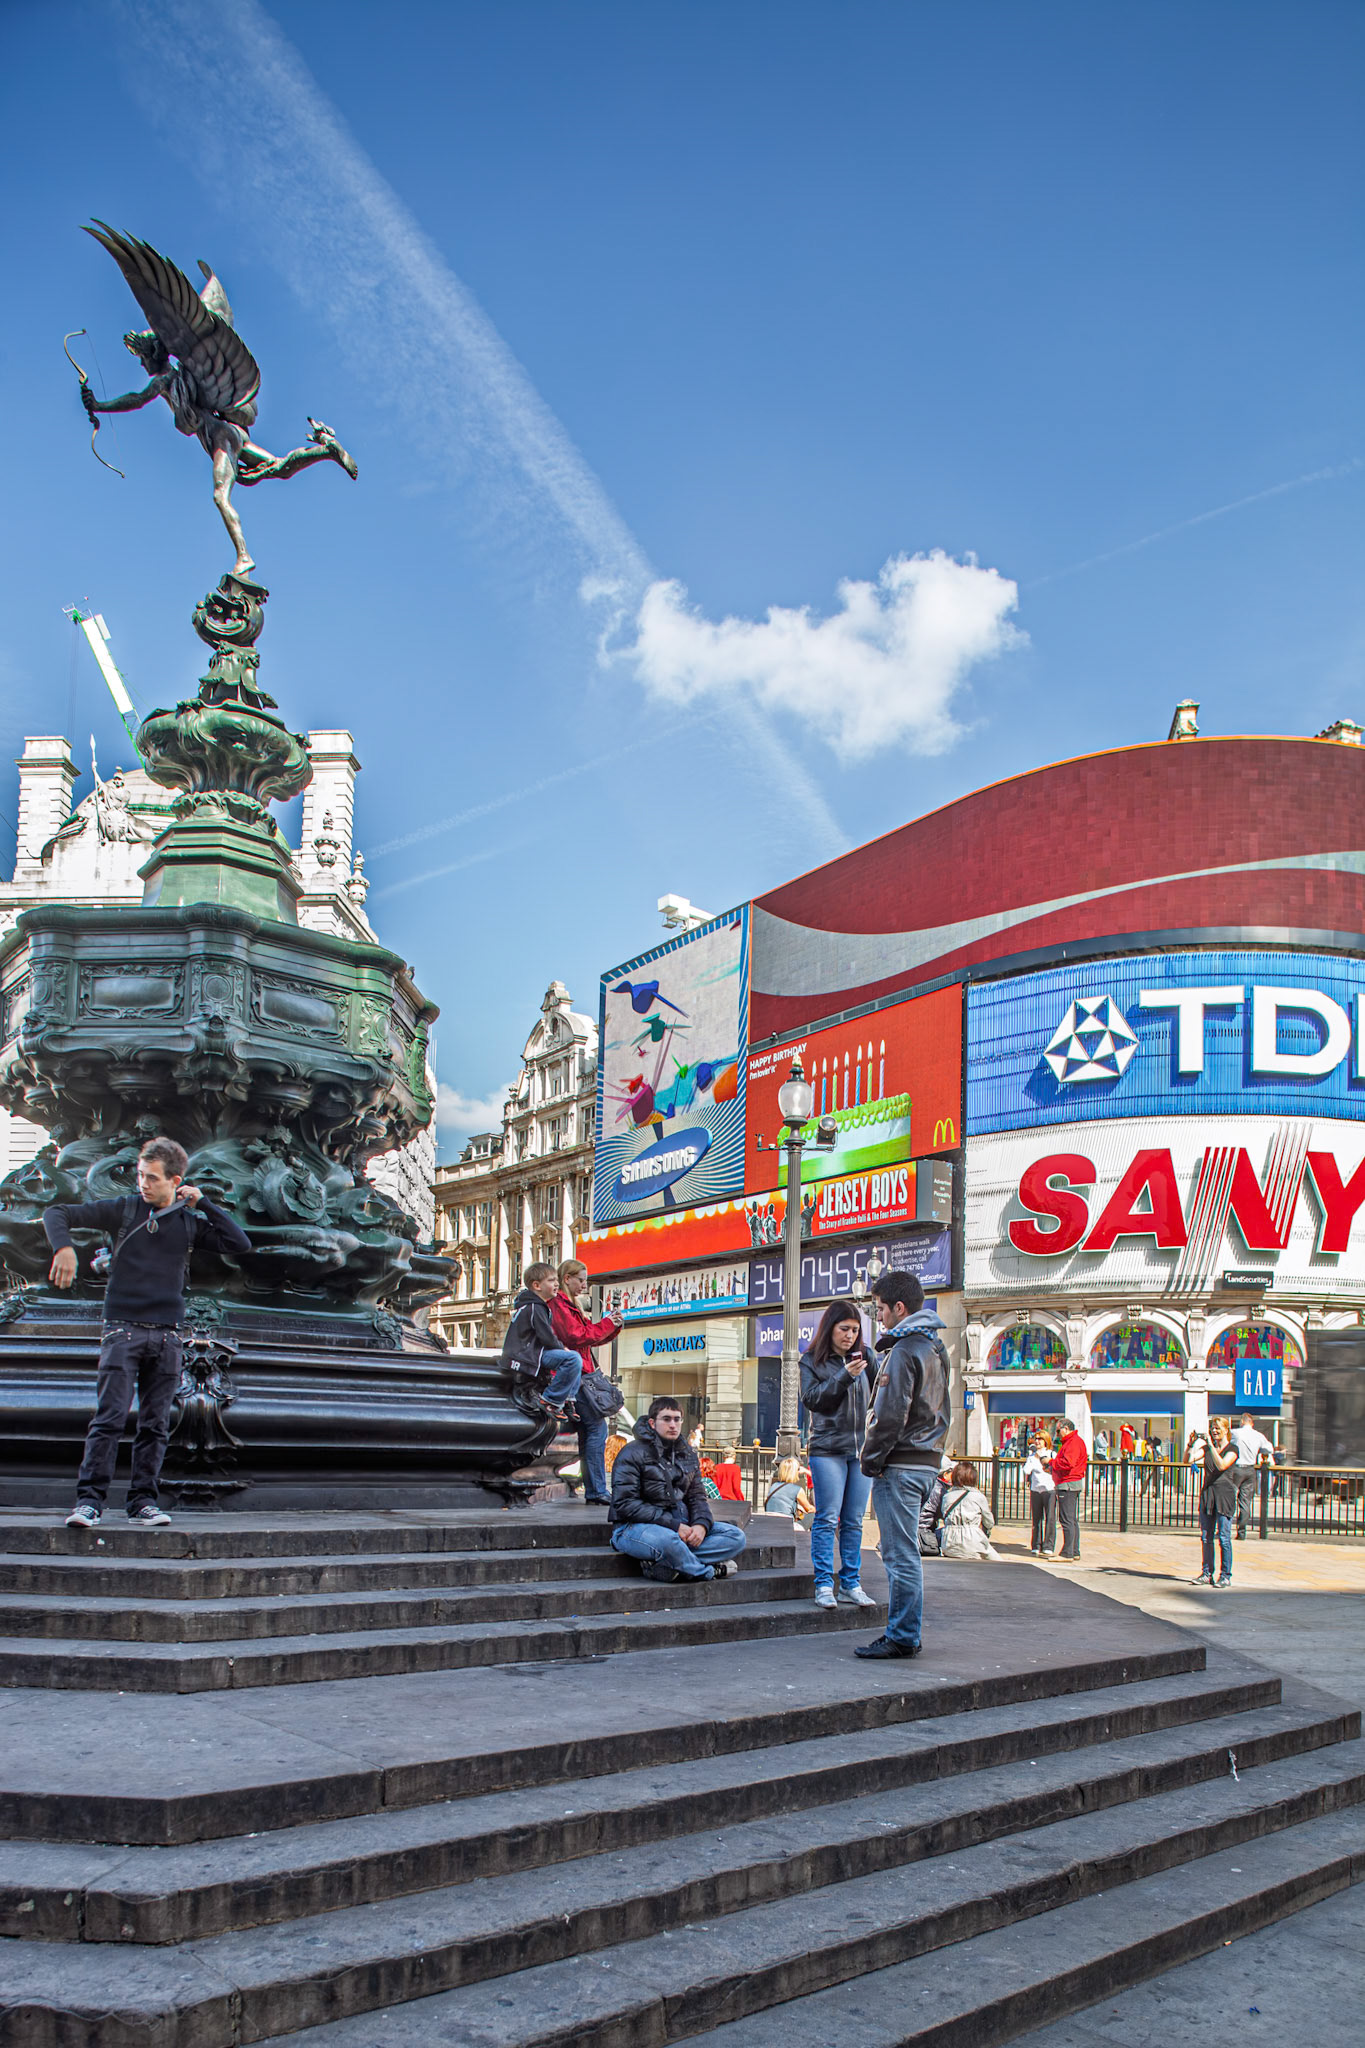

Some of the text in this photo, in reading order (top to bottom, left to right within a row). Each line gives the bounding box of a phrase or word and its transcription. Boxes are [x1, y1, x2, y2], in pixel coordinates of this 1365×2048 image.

[1139, 985, 1365, 1078] TD
[749, 1042, 807, 1070] HAPPY BIRTHDAY
[620, 1145, 696, 1185] SAMSUNG
[819, 1167, 908, 1219] JERSEY BOYS
[1007, 1146, 1365, 1257] SANY
[826, 1220, 836, 1230] Story
[838, 1218, 842, 1227] of
[842, 1216, 856, 1226] Frankie
[858, 1214, 866, 1224] Valli
[867, 1212, 872, 1222] &
[880, 1210, 889, 1220] Four
[890, 1208, 908, 1218] Seasons
[891, 1238, 930, 1252] pedestrians walk
[891, 1246, 940, 1259] past here every year.
[655, 1334, 706, 1353] BARCLAYS
[760, 1326, 814, 1345] pharacy
[1243, 1369, 1276, 1396] GAP
